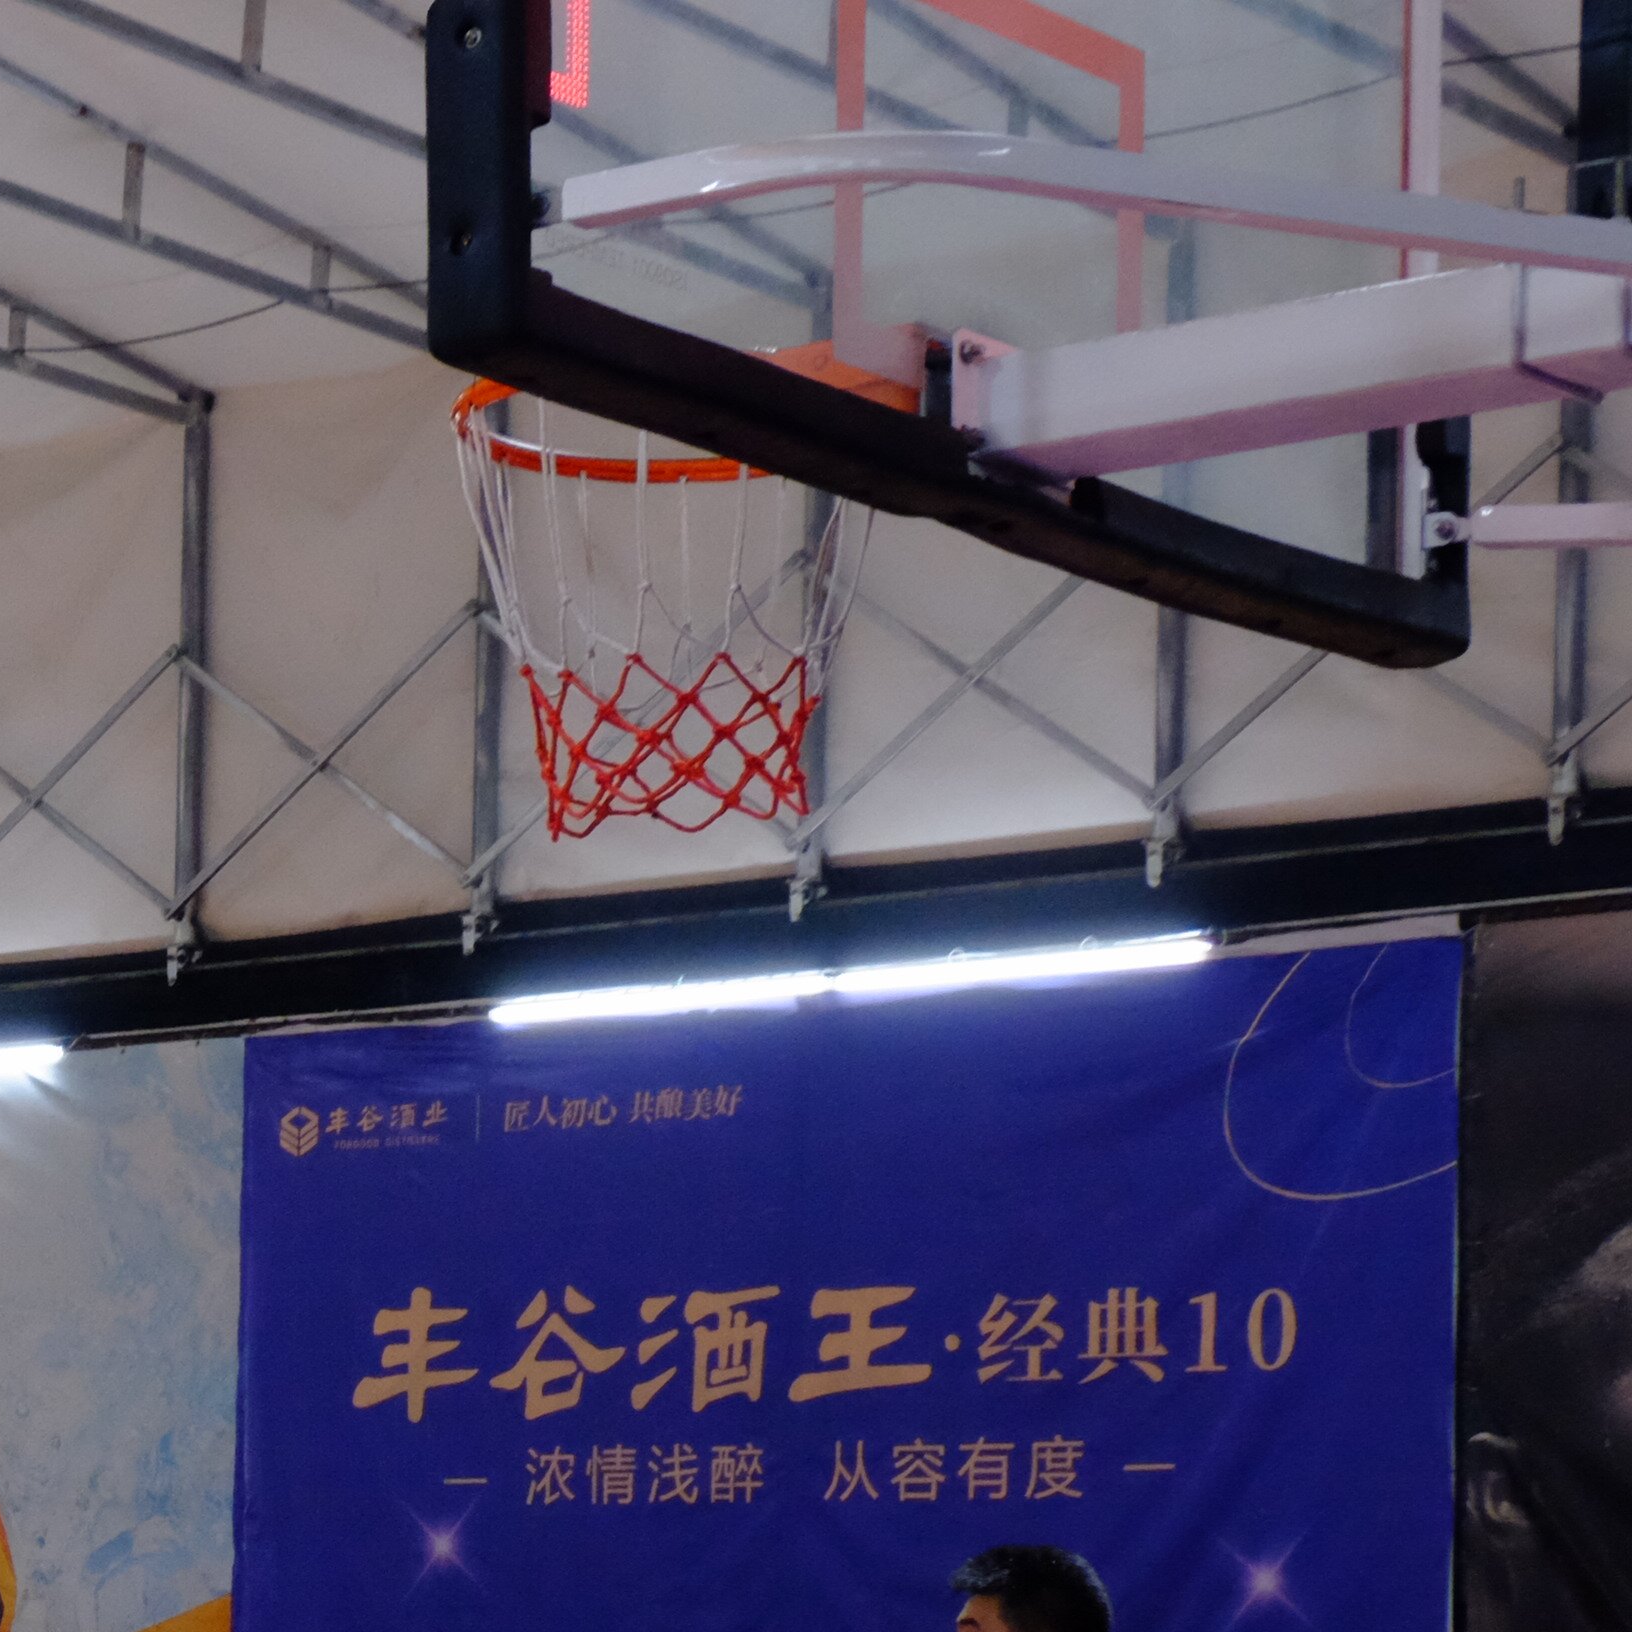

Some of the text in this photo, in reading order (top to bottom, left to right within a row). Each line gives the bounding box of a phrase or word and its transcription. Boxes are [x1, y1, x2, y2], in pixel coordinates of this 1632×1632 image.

[325, 1101, 450, 1135] 丰谷酒业
[503, 1084, 744, 1132] 匠人初心 共酿美好
[525, 1434, 1086, 1505] 浓情浅醉 从容有度
